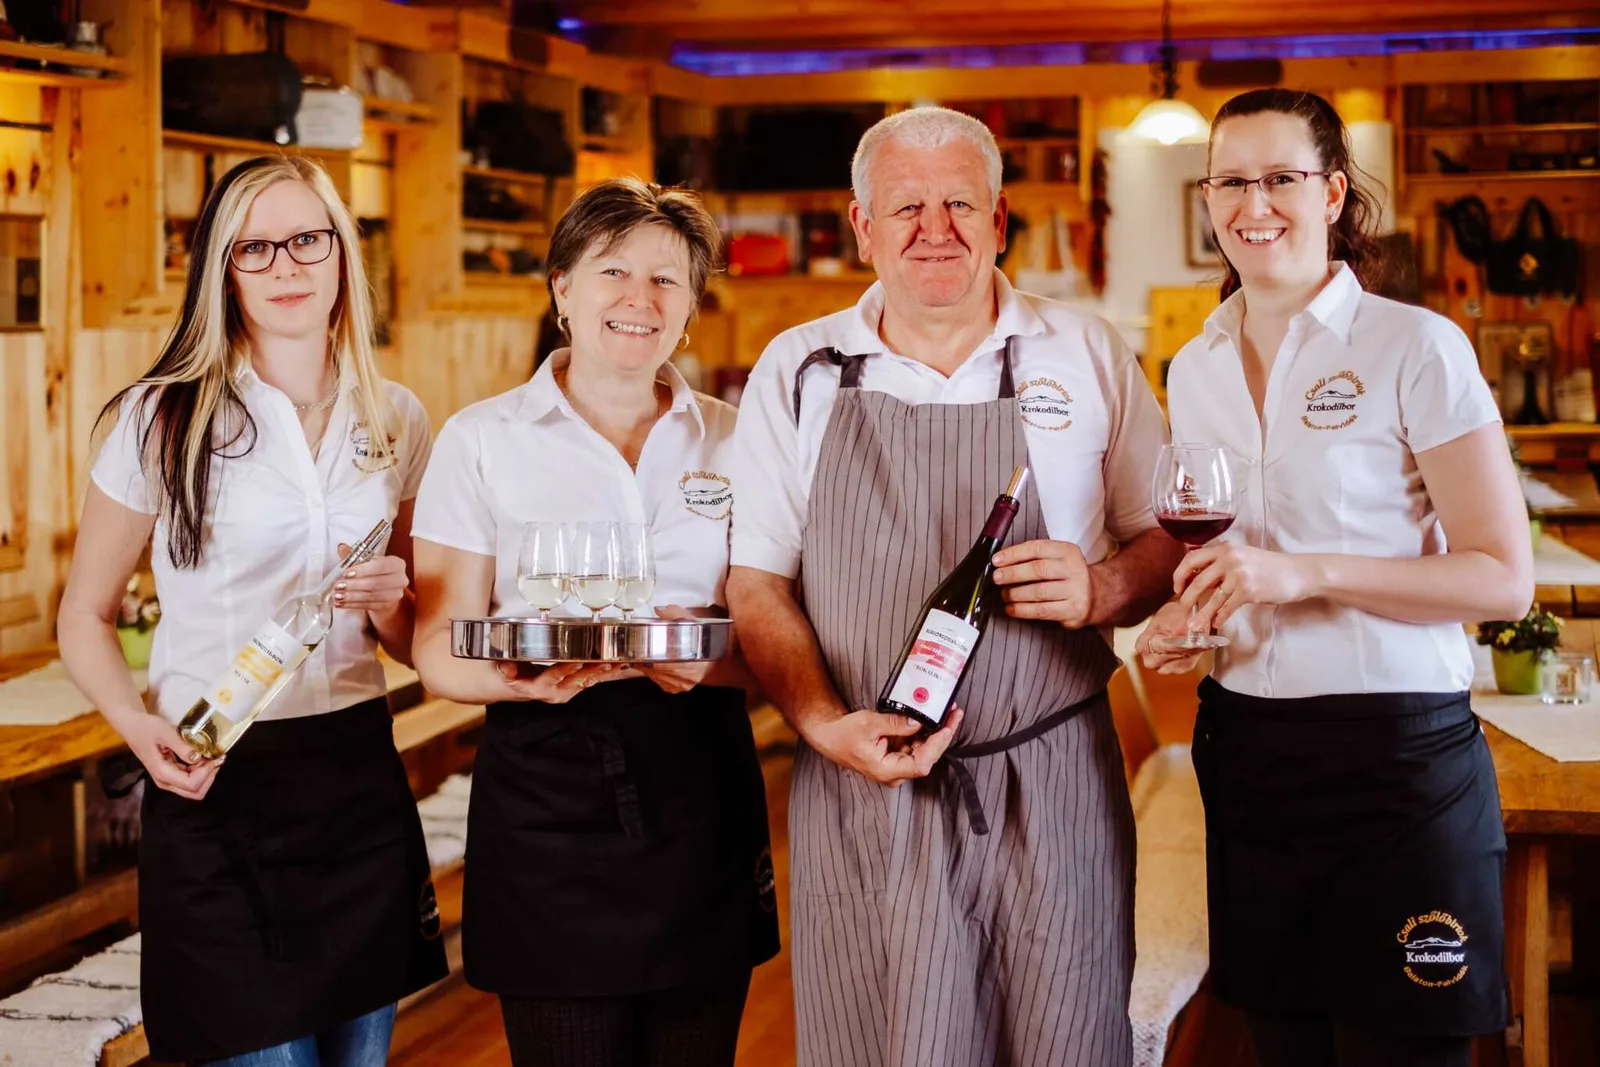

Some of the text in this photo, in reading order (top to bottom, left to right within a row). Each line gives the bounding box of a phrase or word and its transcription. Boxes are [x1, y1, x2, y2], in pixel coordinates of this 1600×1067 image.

[1021, 405, 1069, 416] Krokodilbor
[1306, 403, 1356, 412] Krokodilbor
[1396, 916, 1417, 943] Csali
[1406, 951, 1465, 963] Krokodilbor
